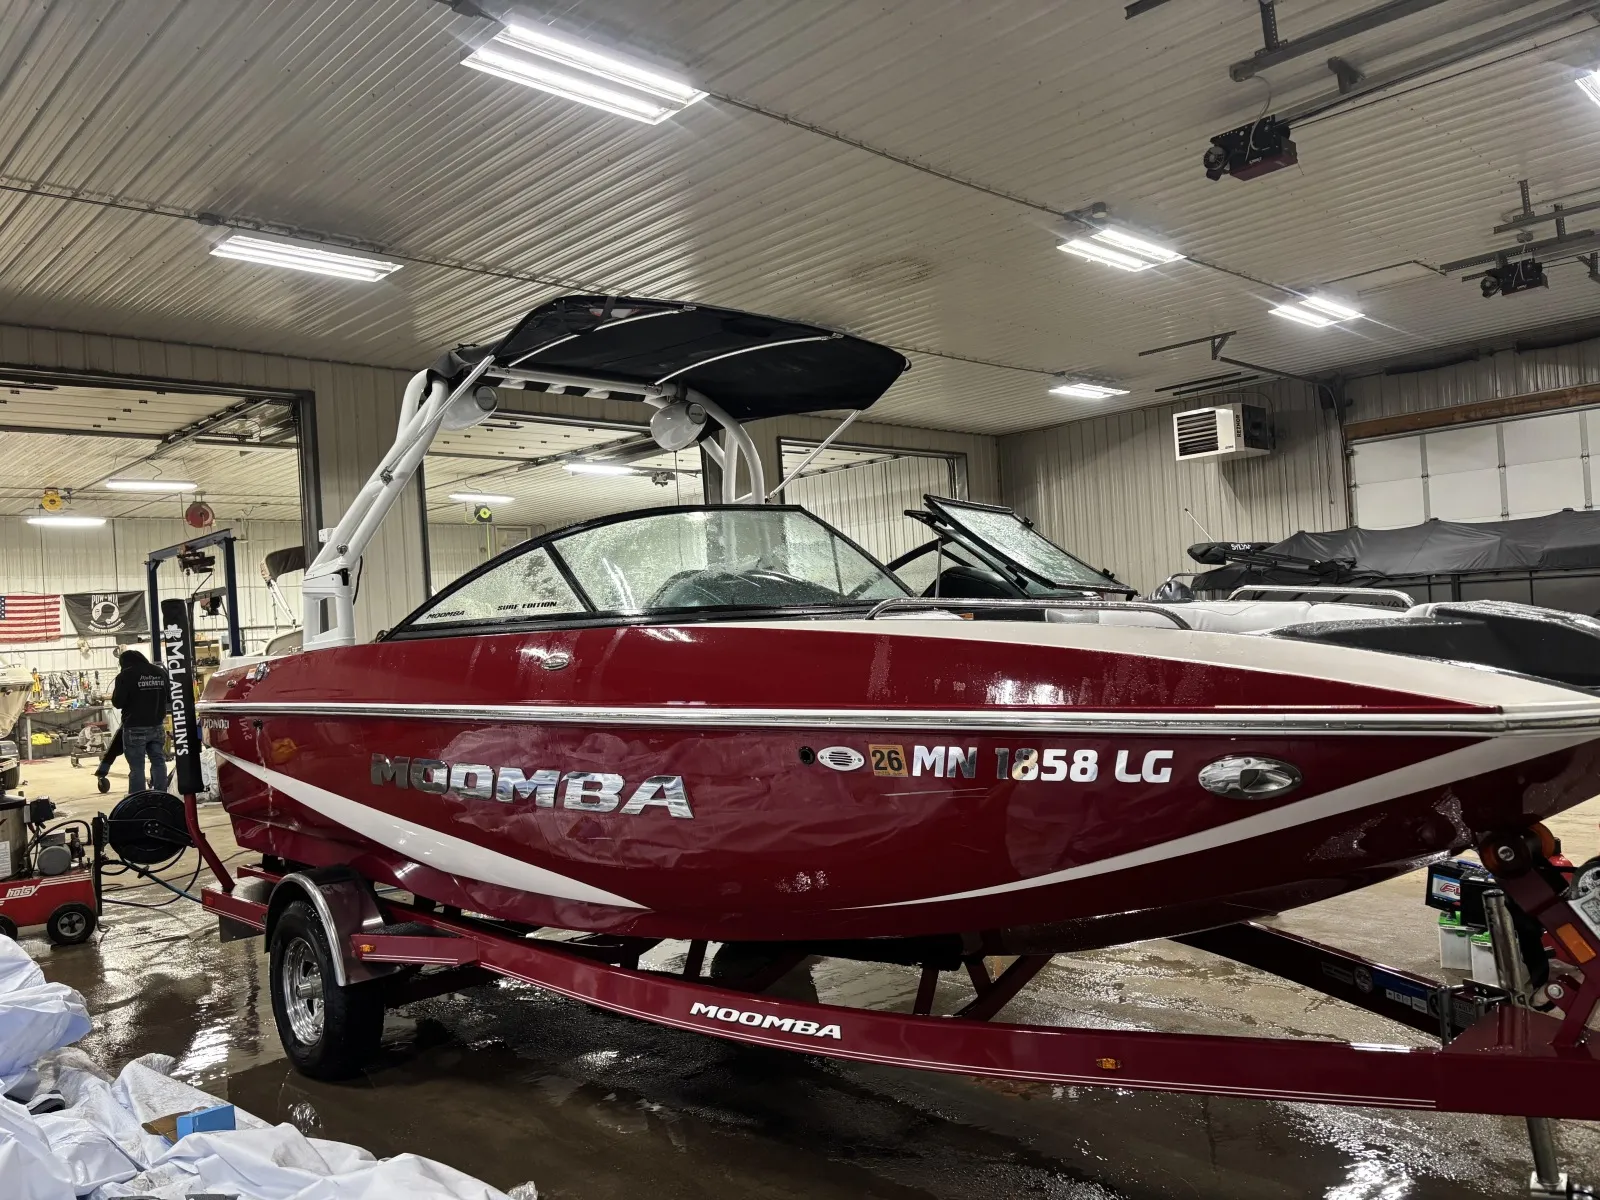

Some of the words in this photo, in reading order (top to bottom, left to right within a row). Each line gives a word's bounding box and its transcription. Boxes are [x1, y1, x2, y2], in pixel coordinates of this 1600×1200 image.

[91, 594, 104, 609] POW
[107, 593, 119, 608] MIA
[522, 601, 557, 609] EDITION
[426, 610, 465, 619] MOOMBA
[871, 749, 903, 771] 26
[912, 745, 977, 778] MN
[995, 748, 1098, 782] 1858
[1115, 750, 1174, 783] LG
[370, 752, 695, 819] MOOMBA
[6, 885, 40, 898] hotsy
[690, 1002, 842, 1040] MOOMBA
